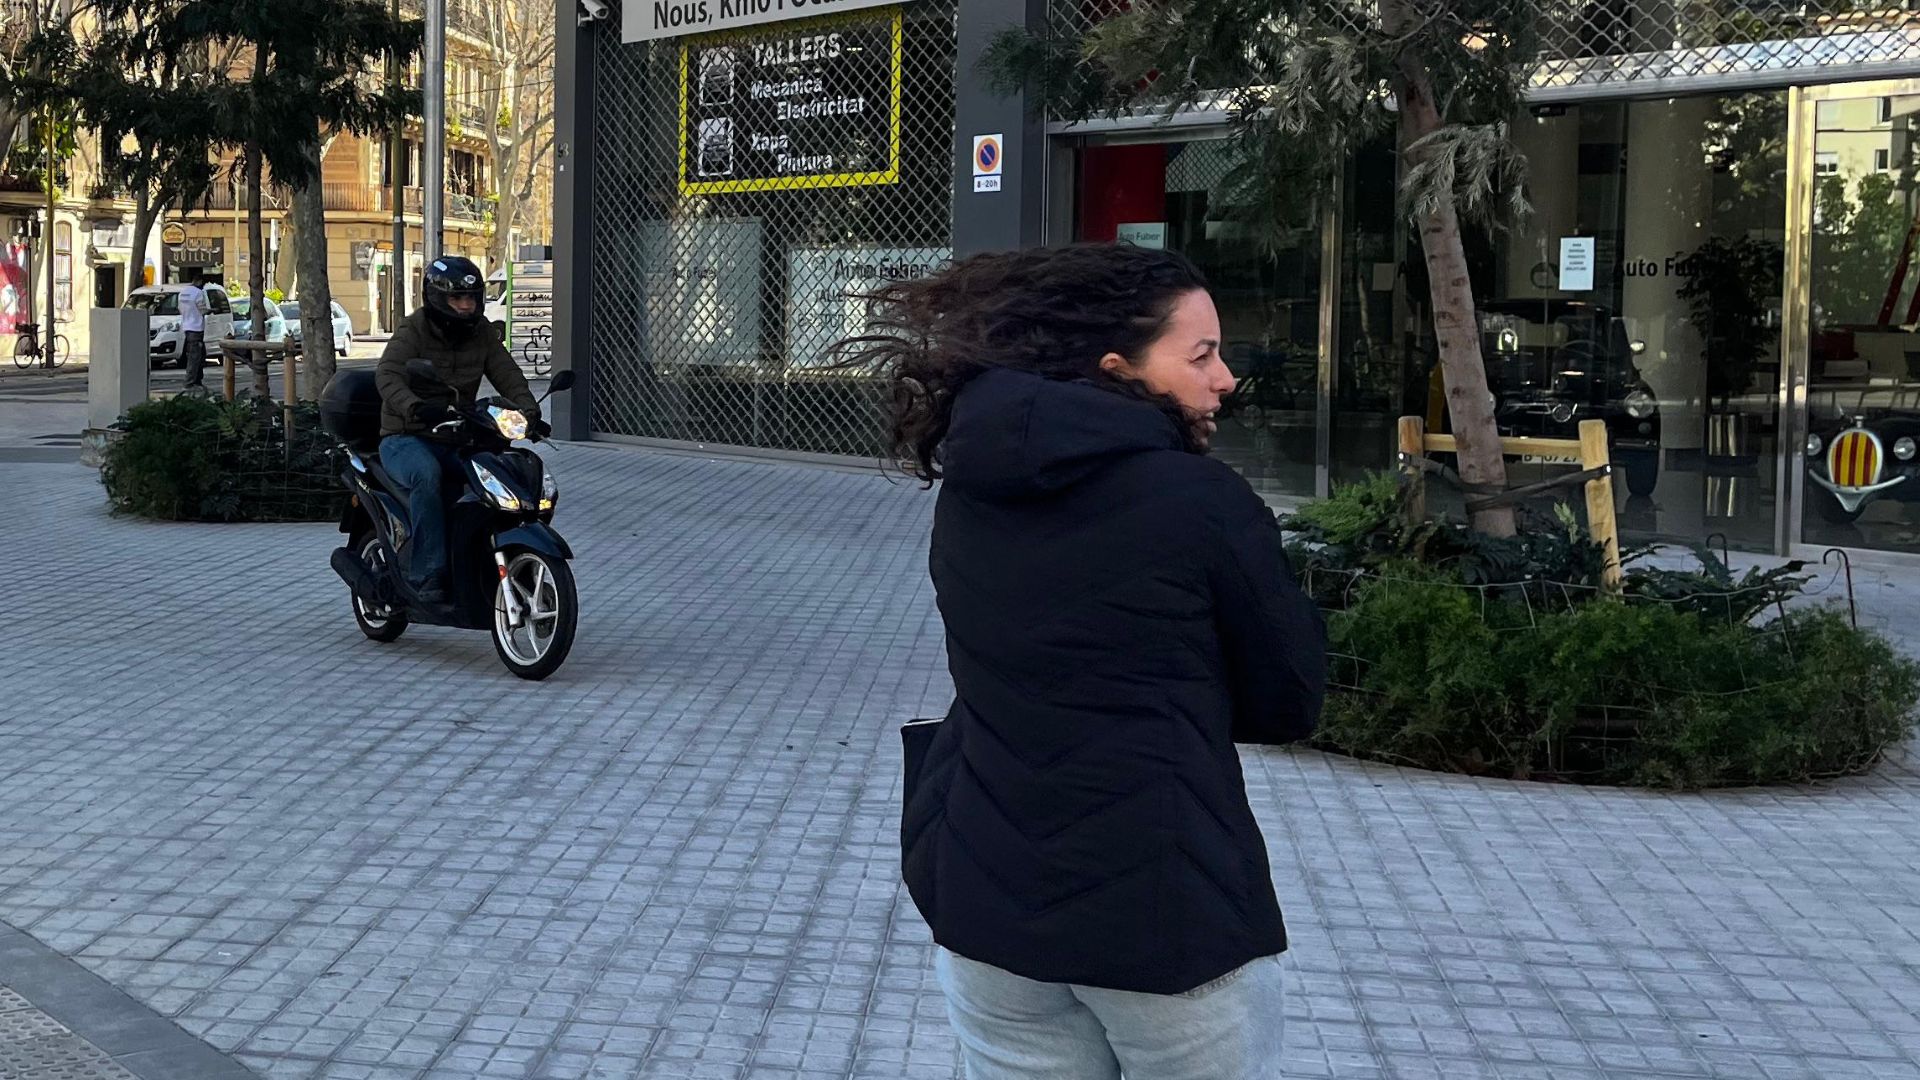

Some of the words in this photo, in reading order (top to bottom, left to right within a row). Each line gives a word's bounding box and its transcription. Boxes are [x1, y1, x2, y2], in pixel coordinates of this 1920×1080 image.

[654, 0, 712, 30] Nous,
[752, 33, 841, 67] TALLERS
[777, 95, 865, 120] Electricitat
[751, 133, 789, 152] Xapa
[777, 152, 833, 172] Pintura
